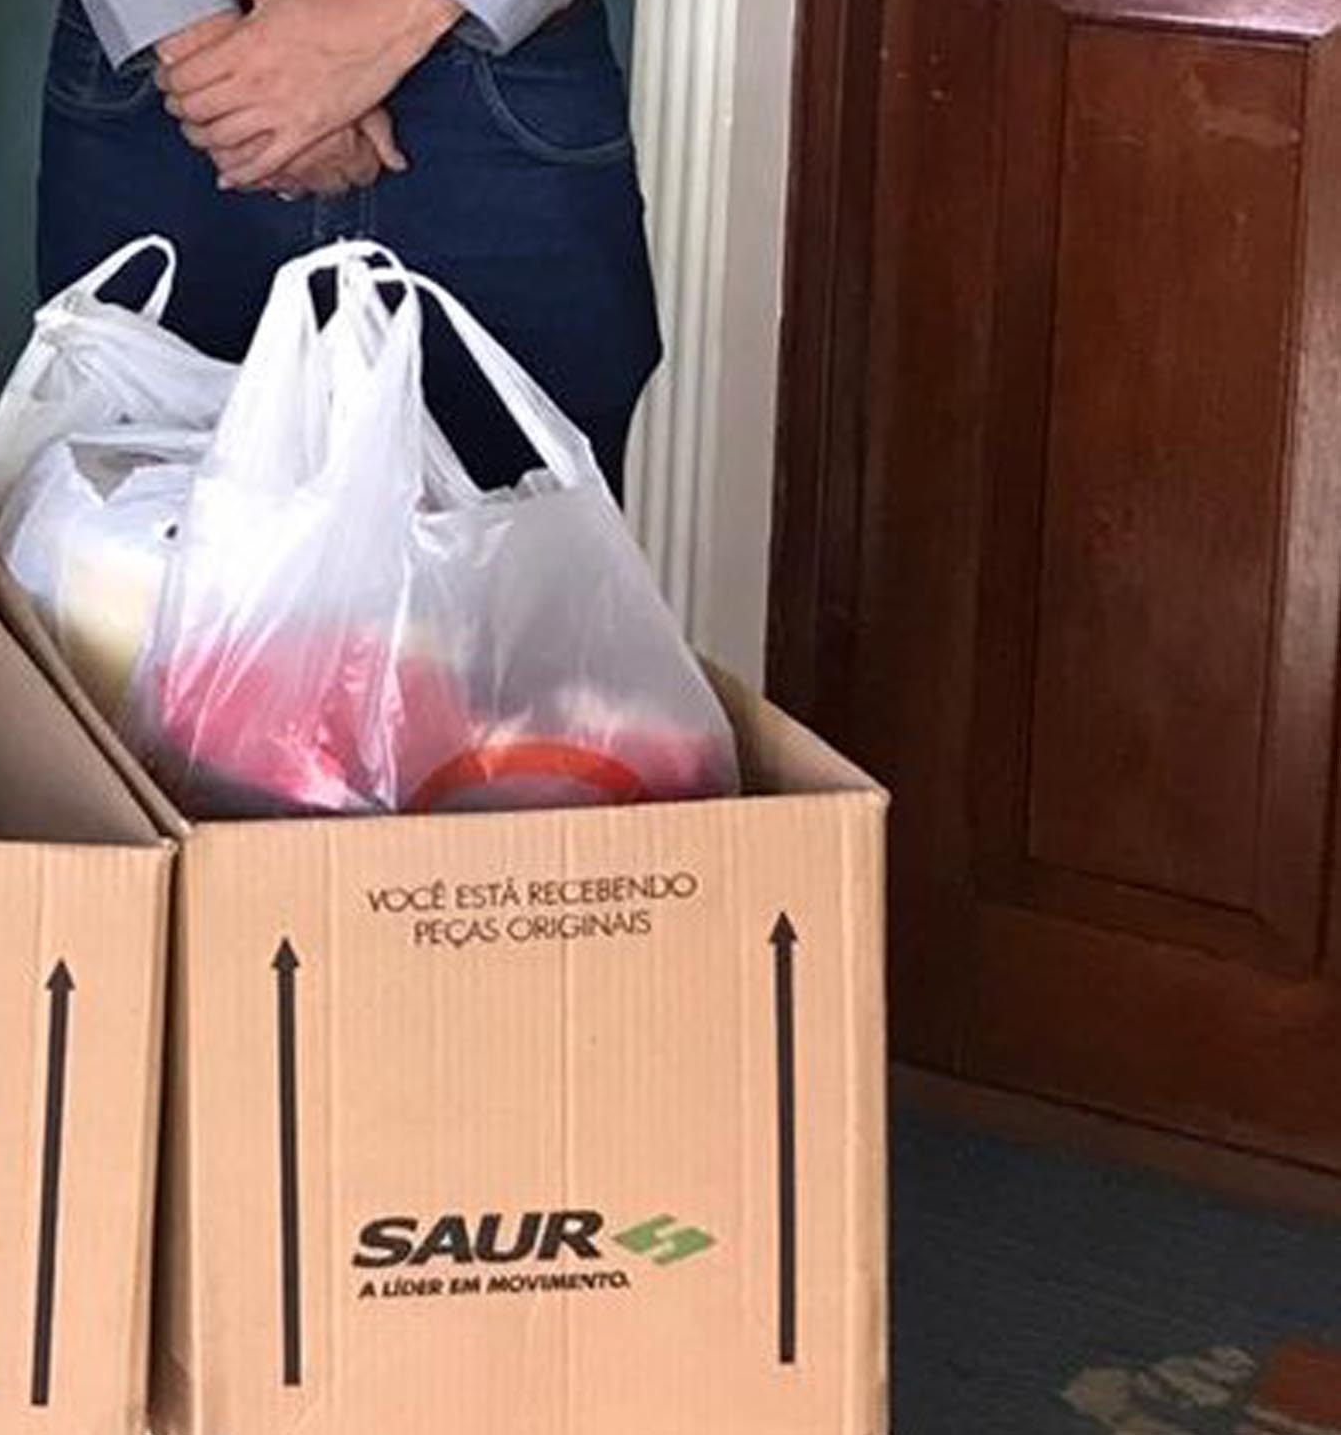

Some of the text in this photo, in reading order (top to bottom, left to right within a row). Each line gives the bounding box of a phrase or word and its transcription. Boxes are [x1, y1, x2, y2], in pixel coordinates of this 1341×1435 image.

[368, 872, 698, 913] VOCÊ ESTÁ RECEBENDO
[415, 911, 652, 948] PEÇAS ORIGINAIS
[352, 1210, 604, 1268] SAUR
[358, 1281, 376, 1299] A
[382, 1275, 443, 1297] LÍDER
[450, 1274, 480, 1295] EM
